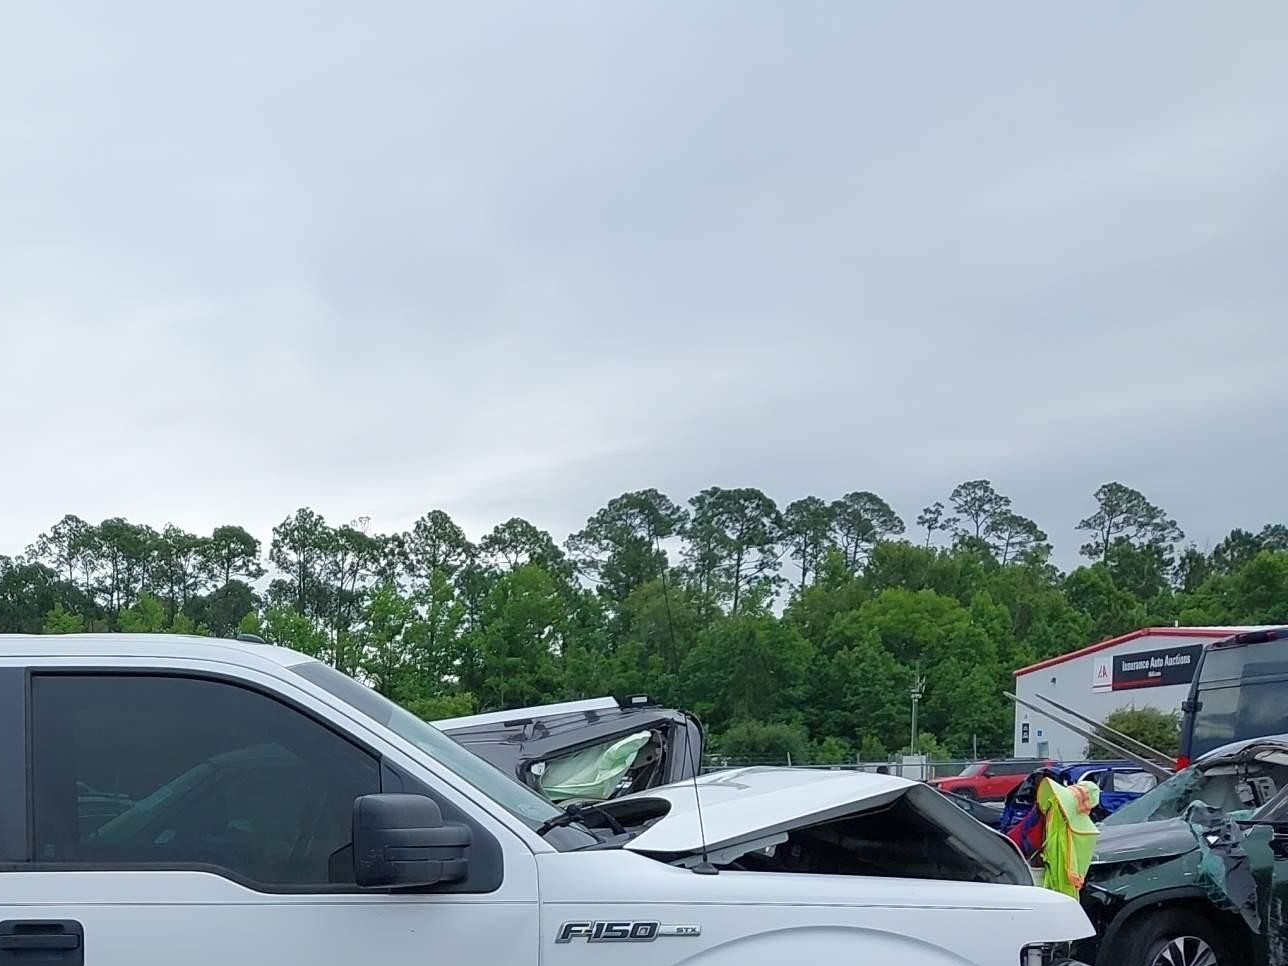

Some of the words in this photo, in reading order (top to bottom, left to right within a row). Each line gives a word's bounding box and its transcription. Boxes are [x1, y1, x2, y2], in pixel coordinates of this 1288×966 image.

[1122, 661, 1149, 671] Insurance
[1150, 657, 1163, 668] Auto
[1164, 654, 1191, 666] Auctions
[555, 920, 662, 944] F-150
